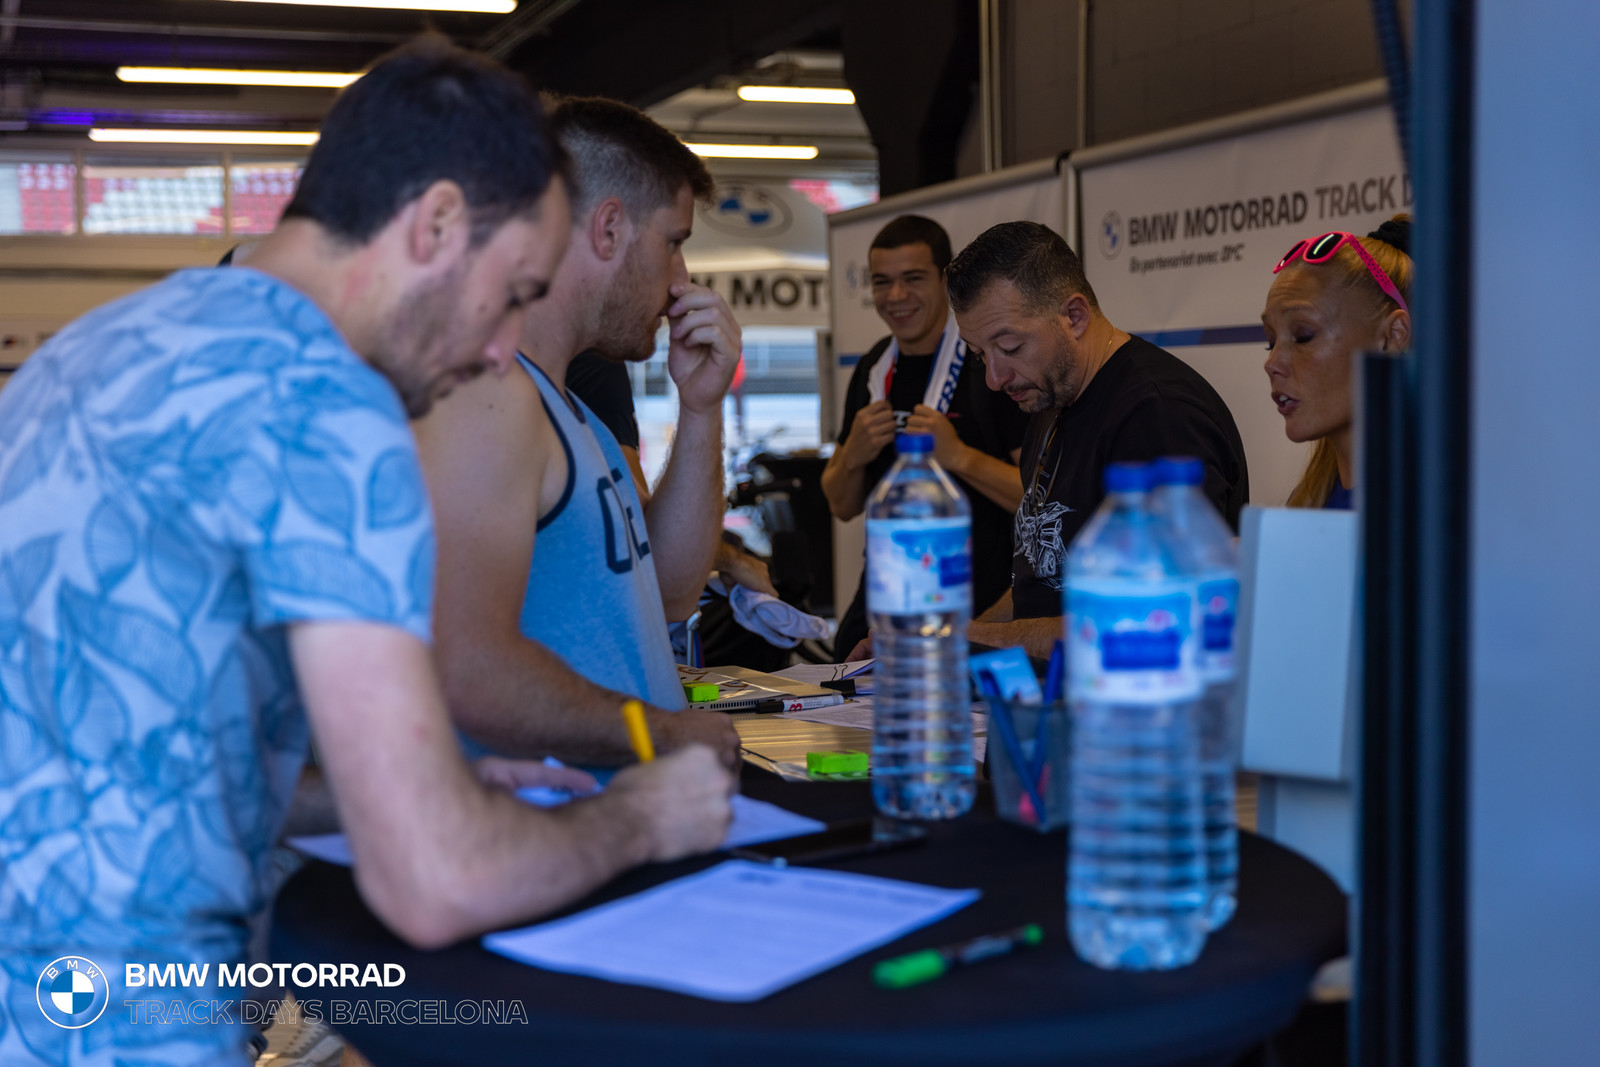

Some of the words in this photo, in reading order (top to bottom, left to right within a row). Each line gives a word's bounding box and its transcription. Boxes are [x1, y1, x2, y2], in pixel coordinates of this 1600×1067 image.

[1128, 210, 1179, 246] BMW
[1184, 191, 1308, 239] MOTORRAD
[1315, 174, 1397, 219] TRACK
